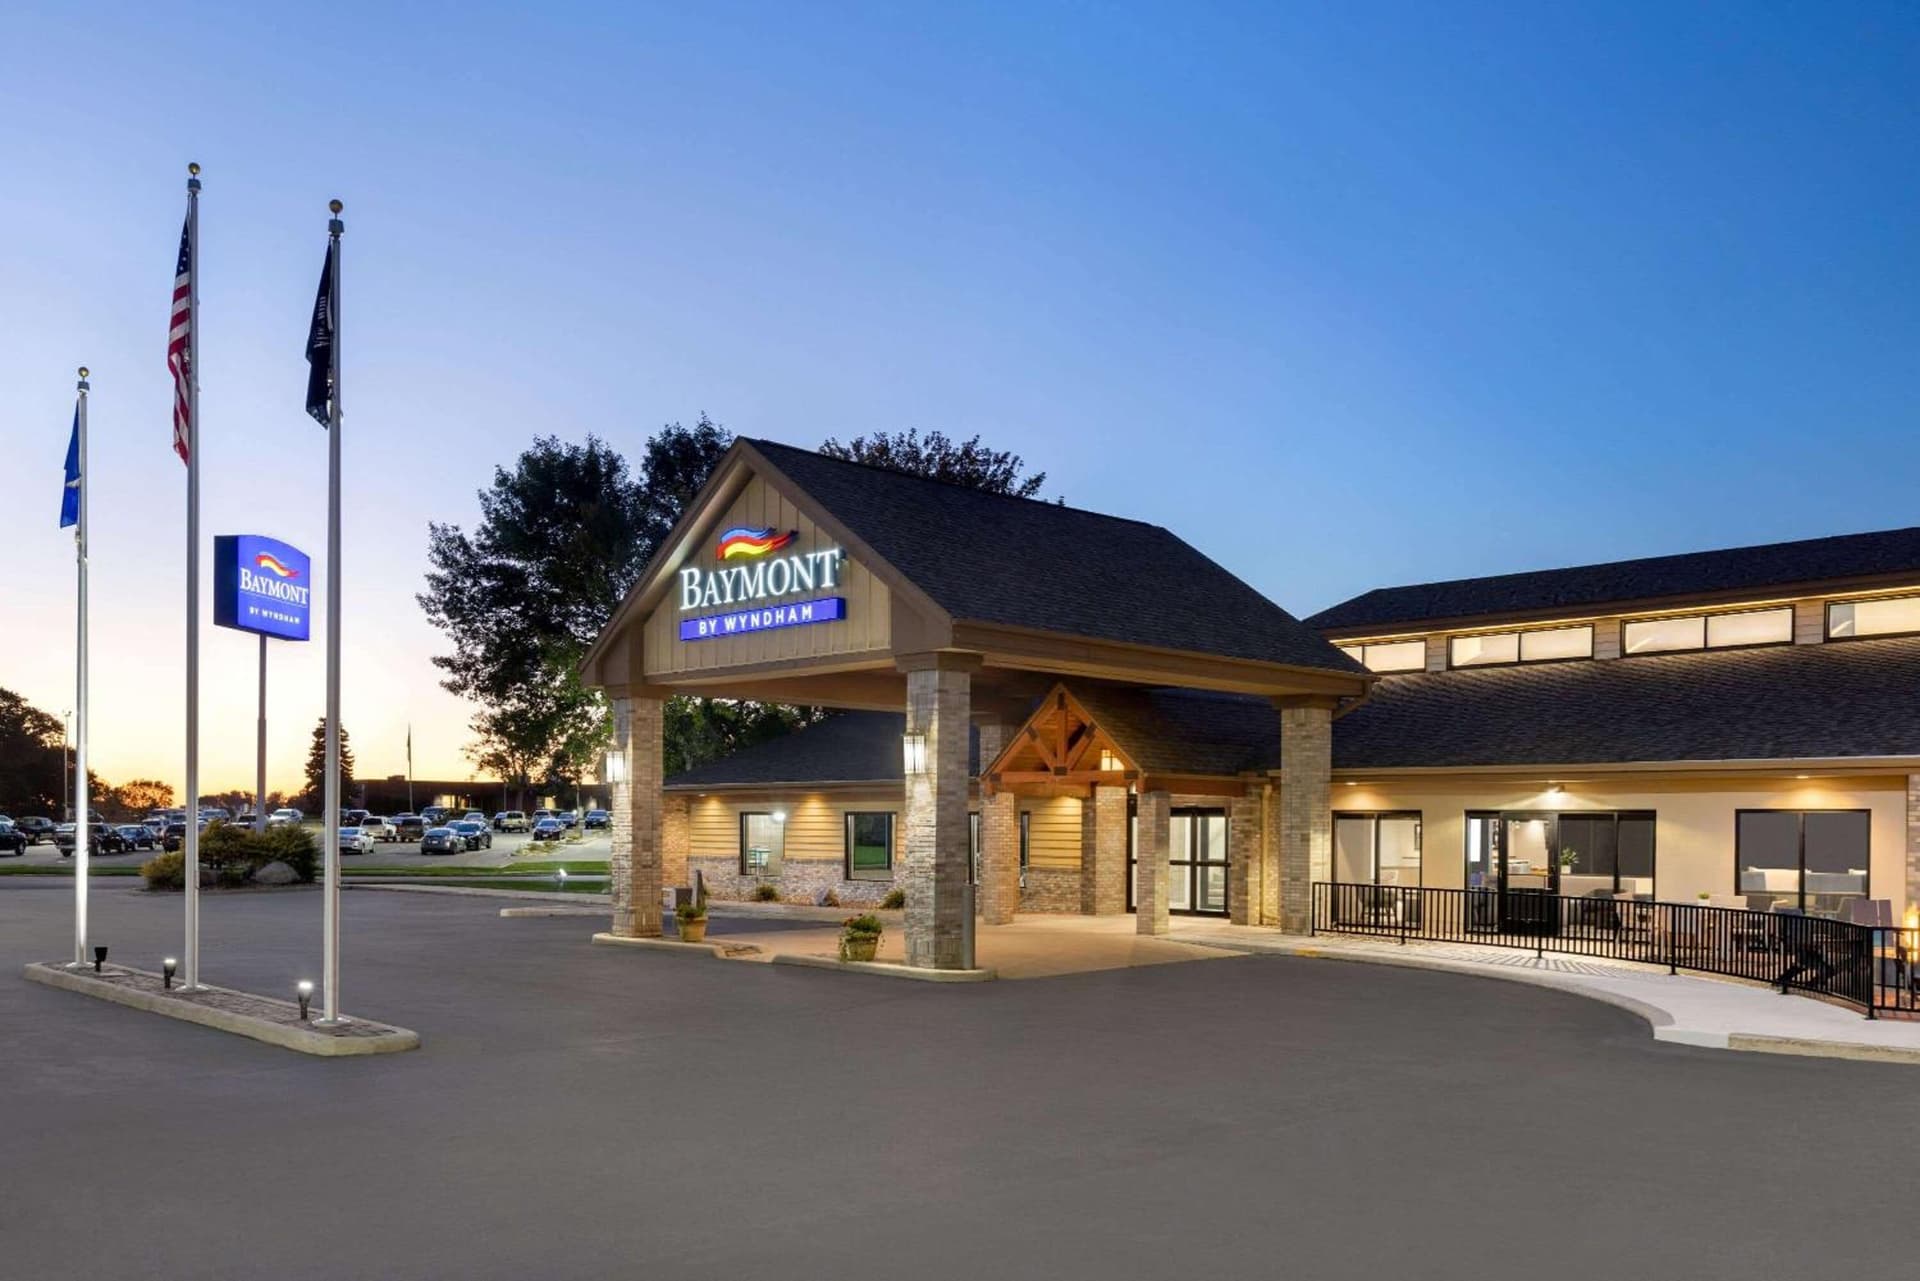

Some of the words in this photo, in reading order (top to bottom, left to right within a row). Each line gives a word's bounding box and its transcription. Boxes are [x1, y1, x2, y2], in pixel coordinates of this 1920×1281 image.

[240, 567, 308, 605] BAYMONT
[679, 548, 840, 610] BAYMONT
[249, 606, 259, 615] BY
[262, 609, 300, 625] WYNDHAM
[699, 620, 717, 635] BY
[724, 605, 813, 631] WYNDHAM
